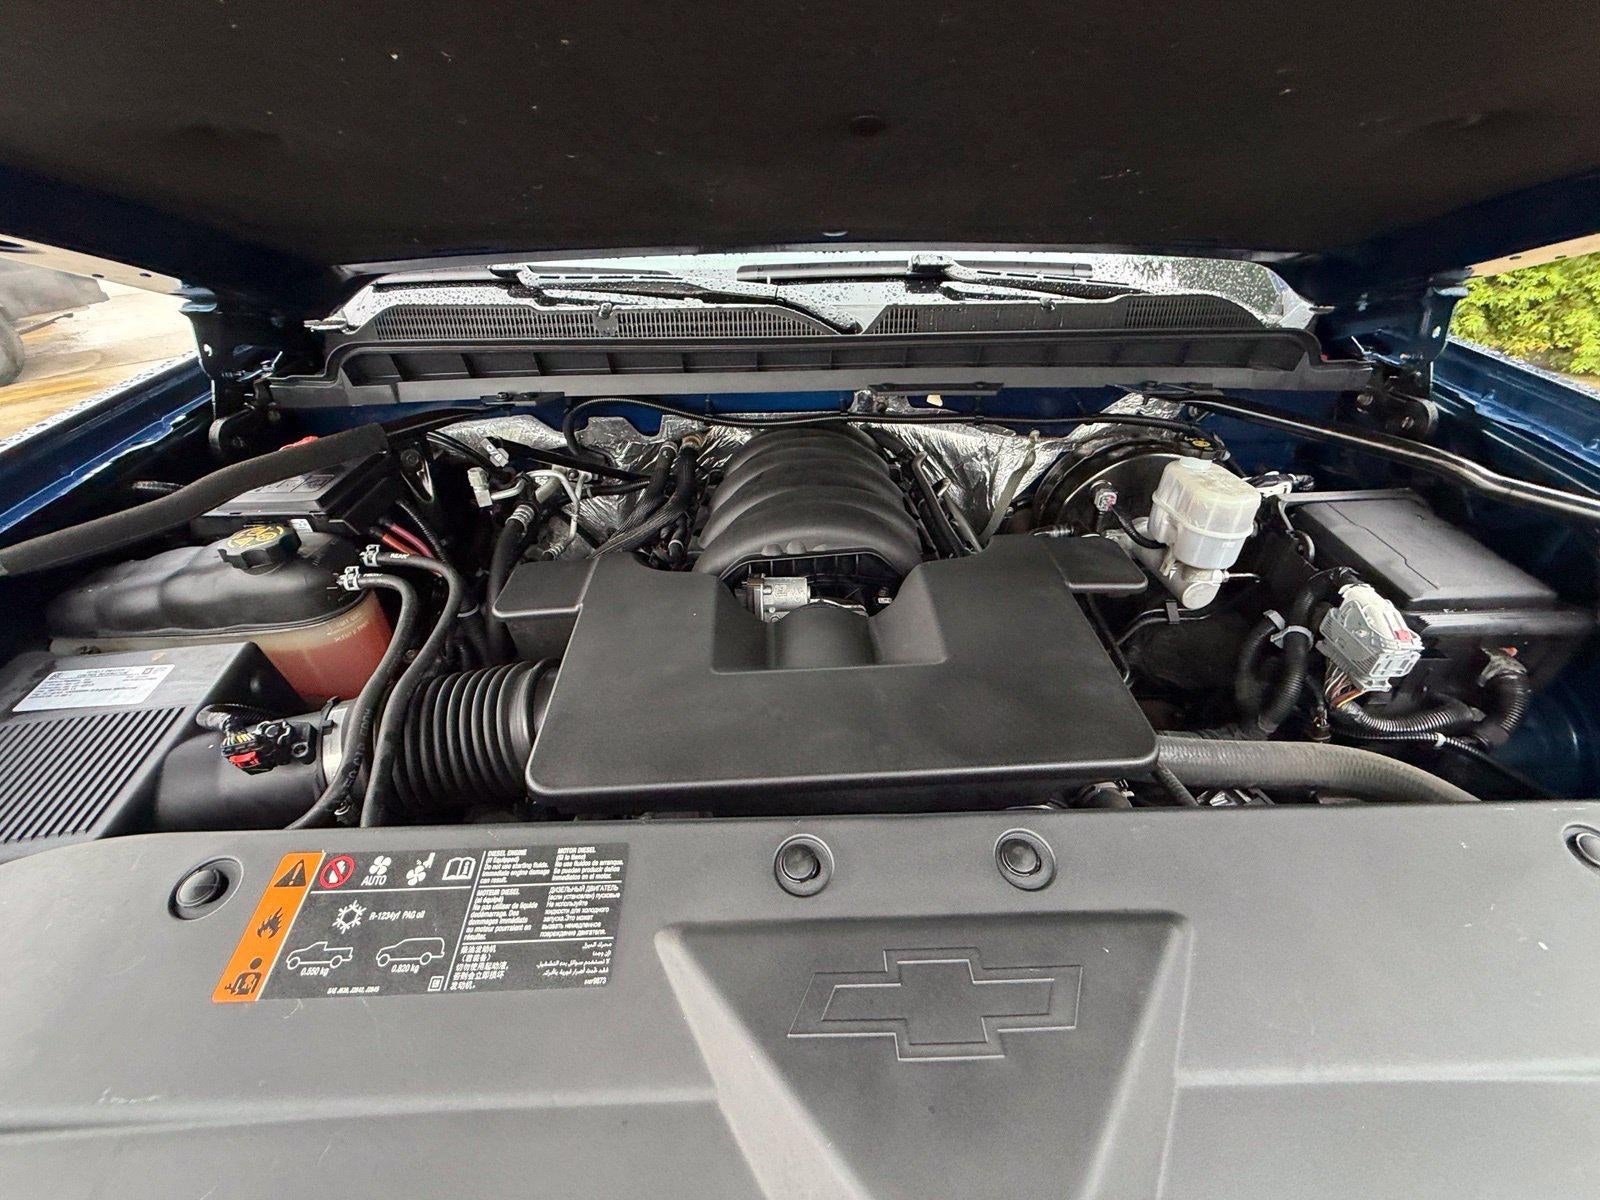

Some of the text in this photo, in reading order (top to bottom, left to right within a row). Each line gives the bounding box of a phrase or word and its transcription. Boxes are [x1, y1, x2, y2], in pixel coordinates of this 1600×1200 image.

[510, 869, 528, 877] engine
[361, 875, 387, 886] AUTO
[402, 910, 416, 919] PAG
[416, 910, 426, 918] oil
[320, 966, 330, 977] kg
[410, 964, 420, 974] kg
